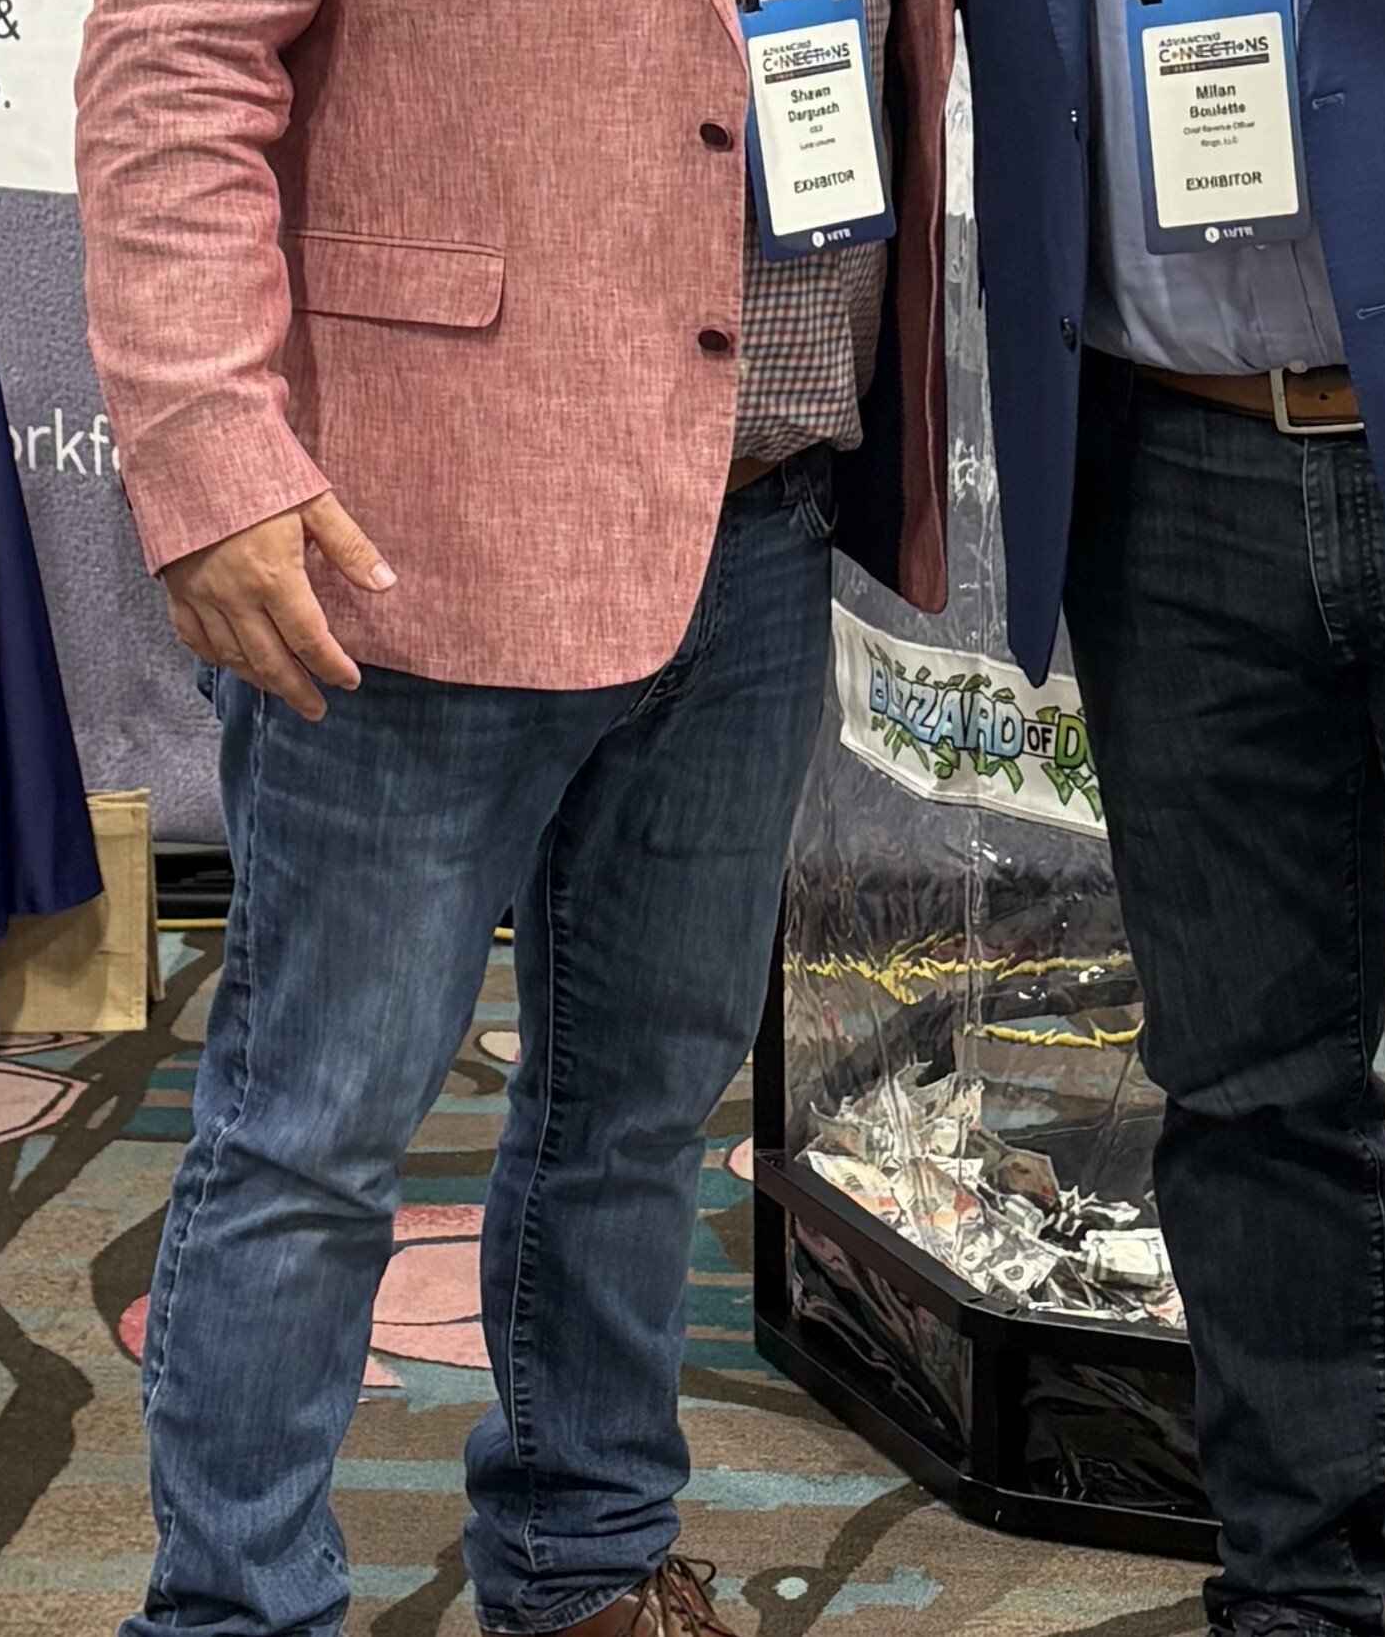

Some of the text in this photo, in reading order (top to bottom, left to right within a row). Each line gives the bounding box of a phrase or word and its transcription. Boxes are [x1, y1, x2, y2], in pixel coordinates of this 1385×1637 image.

[791, 86, 831, 103] Shawn
[1195, 83, 1236, 100] Milan
[794, 169, 855, 194] EXHIBITOR
[1185, 171, 1263, 191] EXHIBITOR
[1026, 722, 1053, 753] OF
[1055, 713, 1089, 770] D
